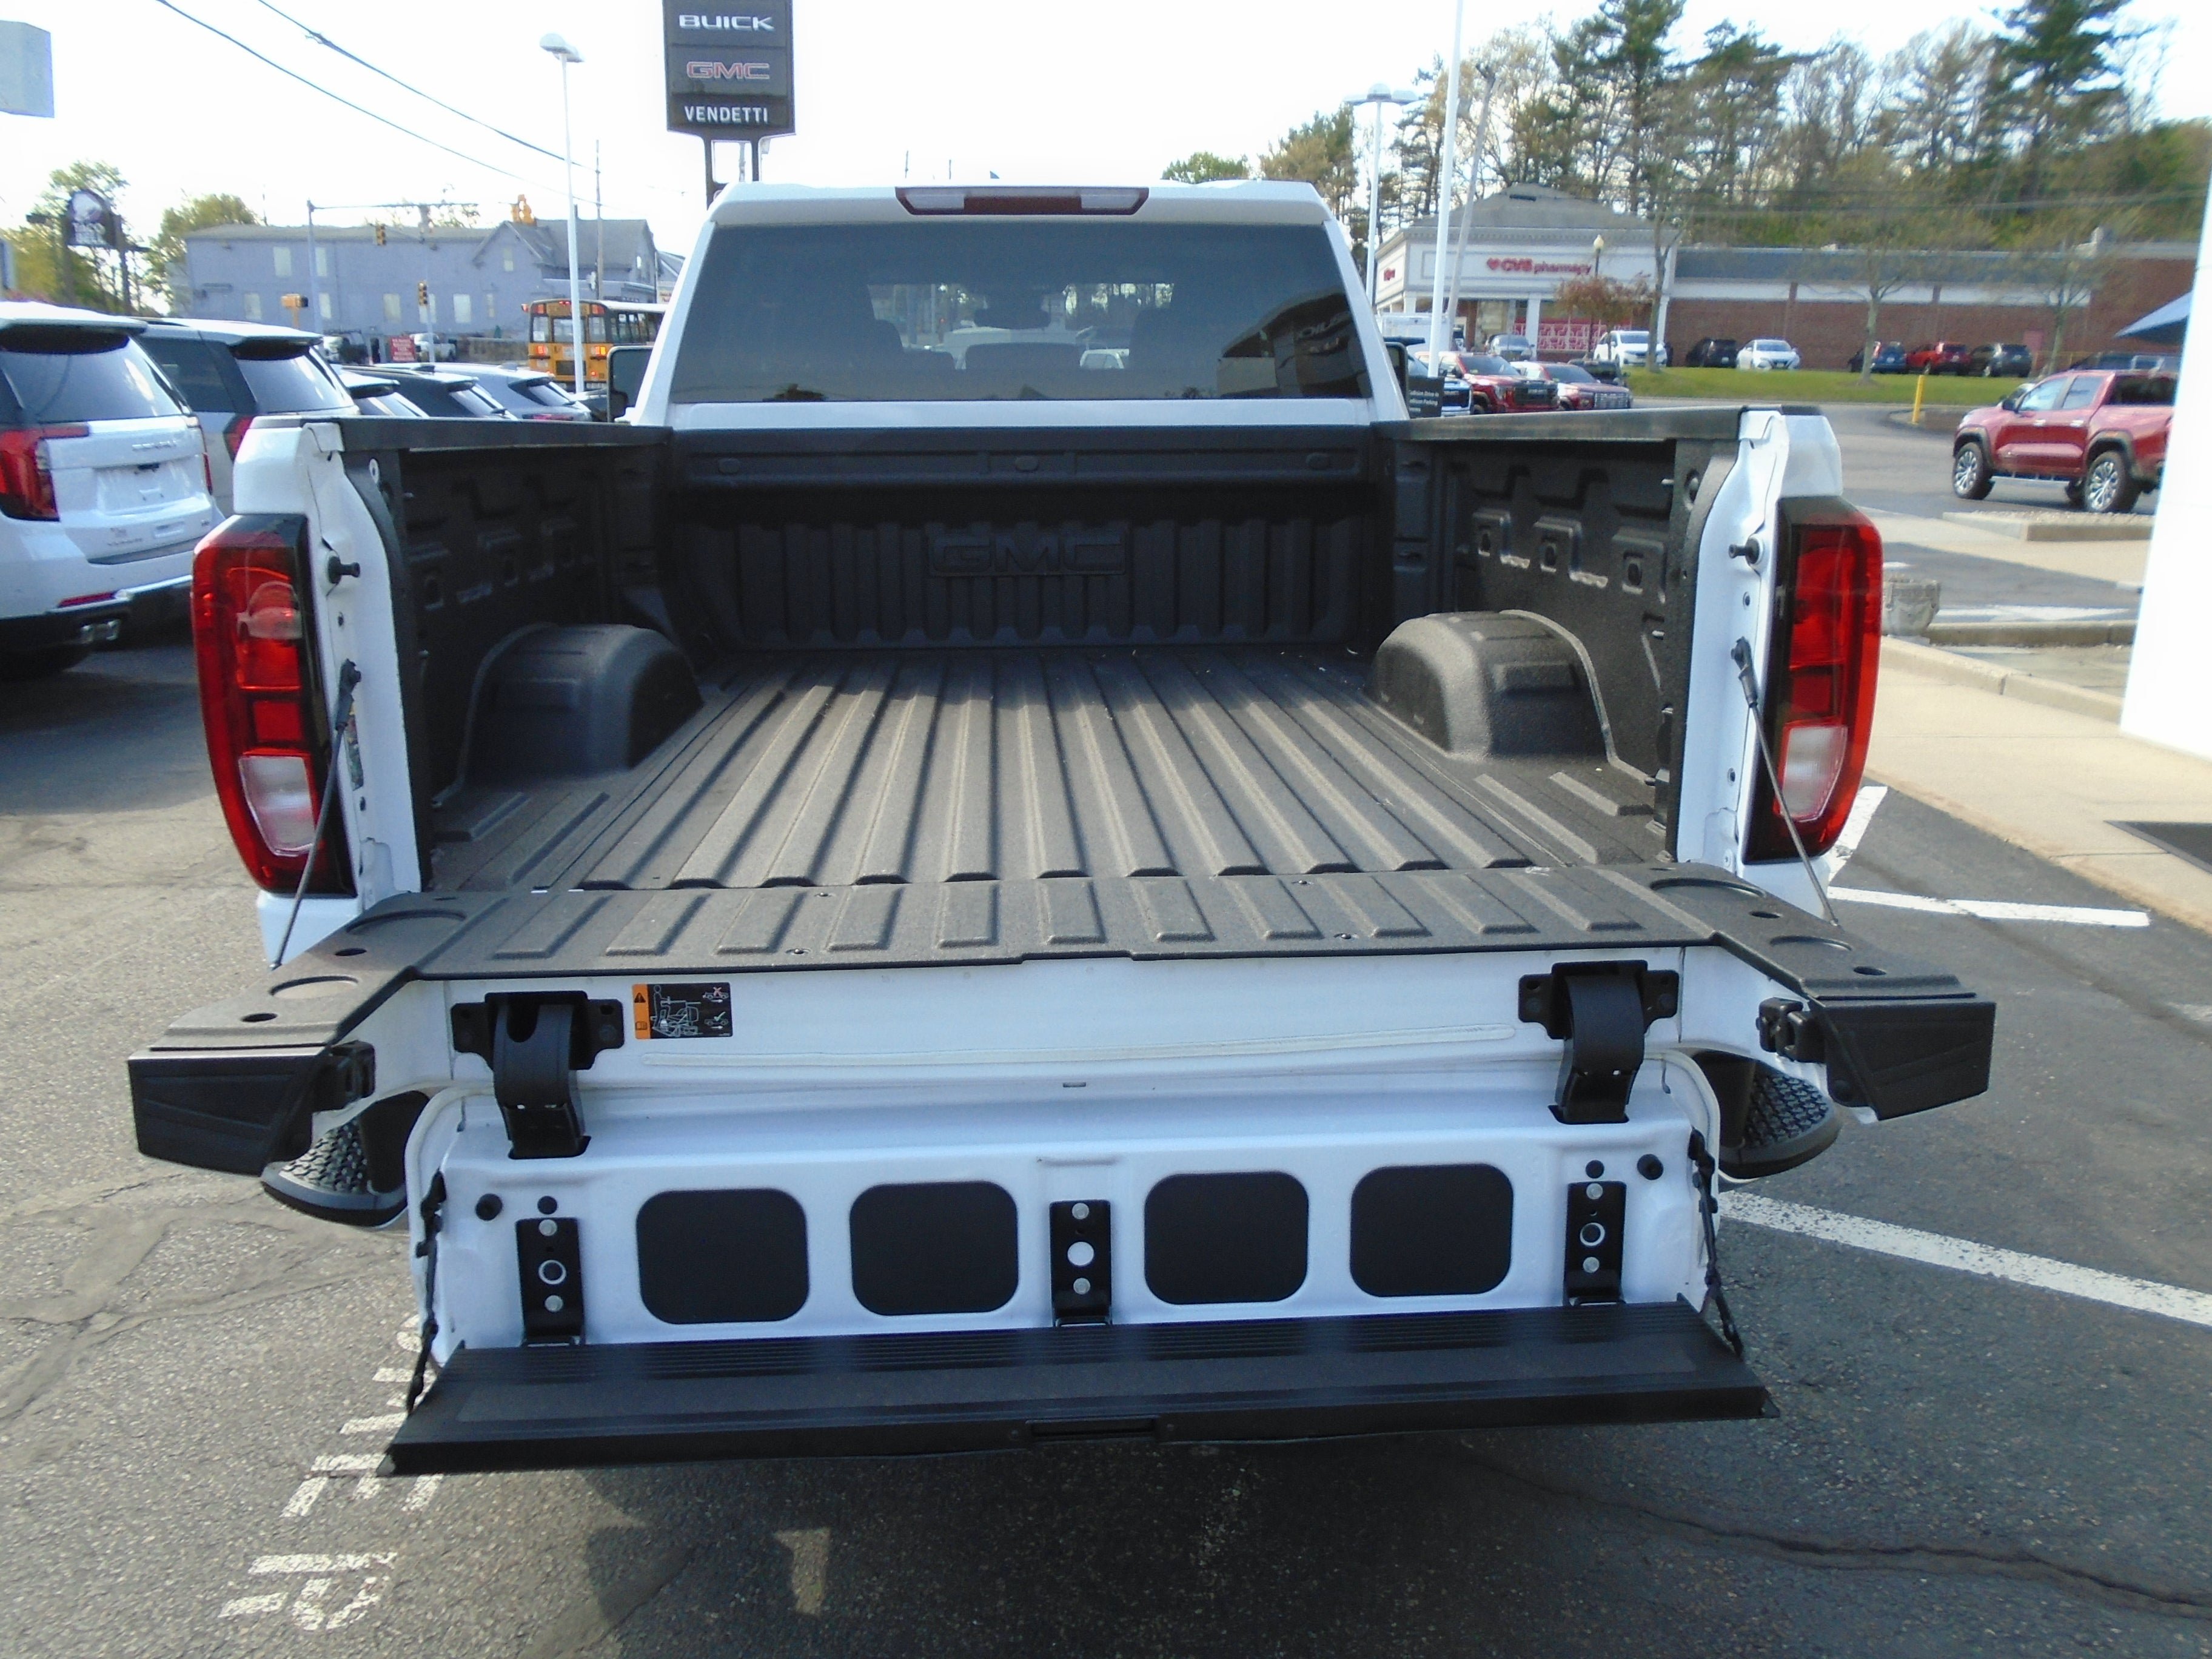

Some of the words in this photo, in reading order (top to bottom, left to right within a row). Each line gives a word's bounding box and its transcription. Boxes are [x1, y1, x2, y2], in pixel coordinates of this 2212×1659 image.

[679, 15, 774, 31] BUICK
[686, 61, 770, 79] GMC
[685, 106, 768, 124] VENDETTI
[1501, 258, 1533, 272] CVS
[1533, 261, 1592, 275] pharmacy
[930, 532, 1125, 573] GMC
